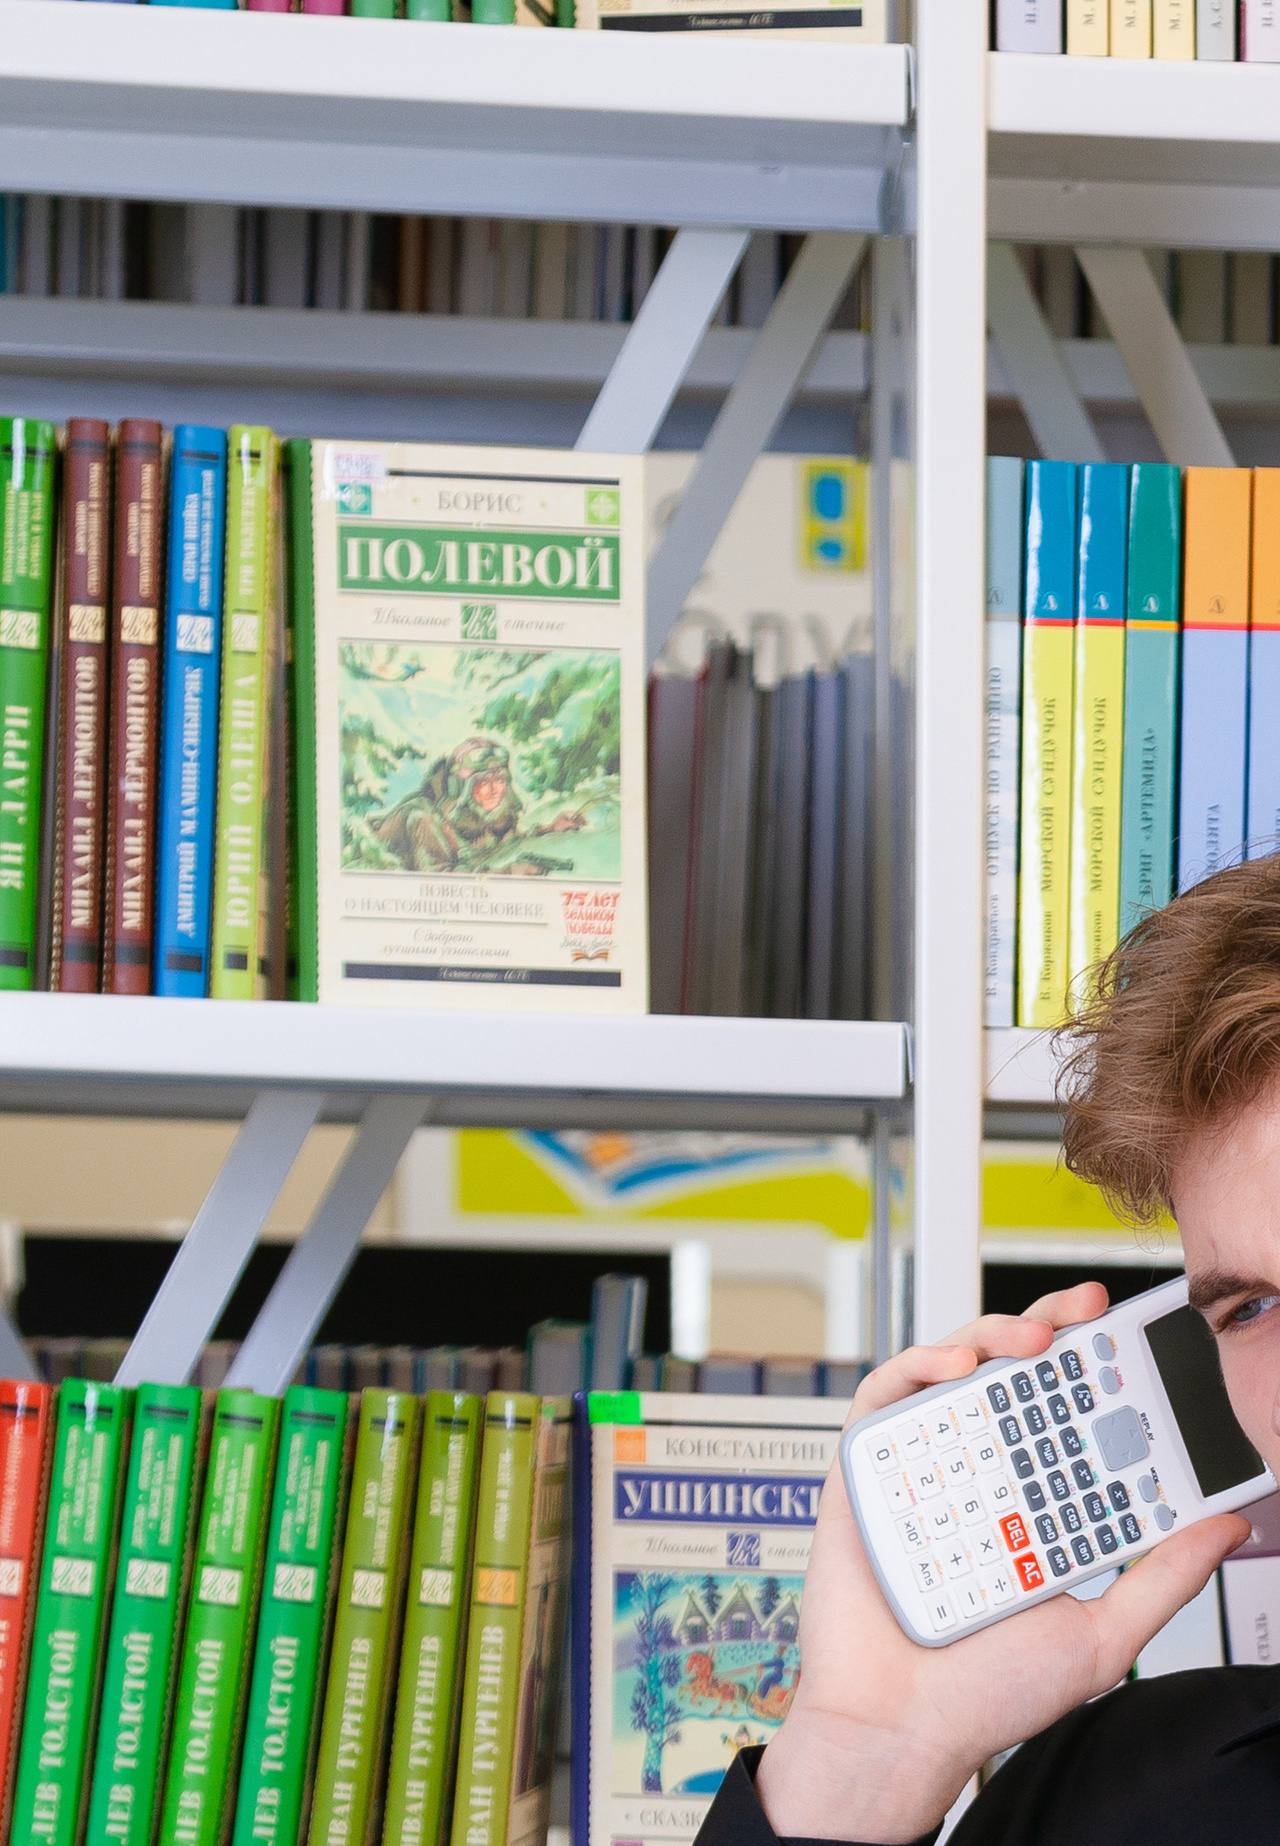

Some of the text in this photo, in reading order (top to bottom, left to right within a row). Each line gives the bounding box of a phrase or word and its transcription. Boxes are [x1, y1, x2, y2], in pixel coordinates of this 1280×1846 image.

[438, 491, 523, 513] БОРИС
[344, 536, 615, 591] ПОЛЕВОЙ
[986, 666, 1003, 760] РАНЕНИЮ
[1041, 696, 1058, 796] СУНДУЧОК
[1091, 696, 1109, 796] СУНДУЧОК
[70, 655, 97, 929] МИХАИЛ ЛЕРМОНТОВ
[121, 657, 150, 931] МИХАИЛ ЛЕРМОНТОВ
[987, 769, 1001, 795] ПО
[0, 705, 30, 890] ЯН ЛАРРИ
[175, 666, 203, 939] ДМИТРИЙ МАМИН-СИБИРЯК
[224, 673, 258, 928] ЮРИЙ ОЛЕША
[985, 804, 1001, 876] ОТПУСК
[1038, 805, 1055, 893] МОРСКОЙ
[1089, 805, 1106, 893] МОРСКОЙ
[419, 883, 489, 899] ПОВЕСТЬ
[360, 898, 460, 916] НАСТОЯЩЕМ
[465, 901, 544, 918] ЧЕЛОВЕКЕ
[1066, 1354, 1081, 1377] CALC
[993, 1389, 1007, 1409] RCL
[966, 1407, 979, 1419] 7
[937, 1422, 949, 1434] 4
[1005, 1420, 1019, 1441] ENG
[1139, 1412, 1155, 1441] REPLAY
[665, 1437, 824, 1460] КОНСТАНТИН
[906, 1436, 919, 1446] 1
[1042, 1442, 1056, 1462] hyp
[876, 1448, 890, 1461] 0
[980, 1447, 994, 1460] 8
[950, 1462, 965, 1473] 5
[920, 1473, 934, 1487] 2
[1054, 1477, 1066, 1496] sin
[994, 1486, 1008, 1499] 9
[965, 1500, 979, 1513] 6
[1066, 1508, 1079, 1529] cos
[1090, 1498, 1102, 1516] log
[935, 1513, 949, 1526] 3
[1006, 1518, 1026, 1548] DEL
[1078, 1543, 1090, 1561] tan
[919, 1561, 934, 1586] Ans
[1021, 1560, 1041, 1584] AC
[181, 1639, 224, 1779] ТОЛСТОЙ
[258, 1635, 301, 1775] ТОЛСТОЙ
[334, 1637, 373, 1772] ТУРГЕНЕВ
[406, 1635, 441, 1769] ТУРГЕНЕВ
[470, 1625, 506, 1775] ТУРГЕНЕВ
[30, 1629, 78, 1845] ЛЕВ ТОЛСТОЙ
[105, 1631, 153, 1846] ЛЕВ ТОЛСТОЙ
[640, 1808, 702, 1827] СКАЗК
